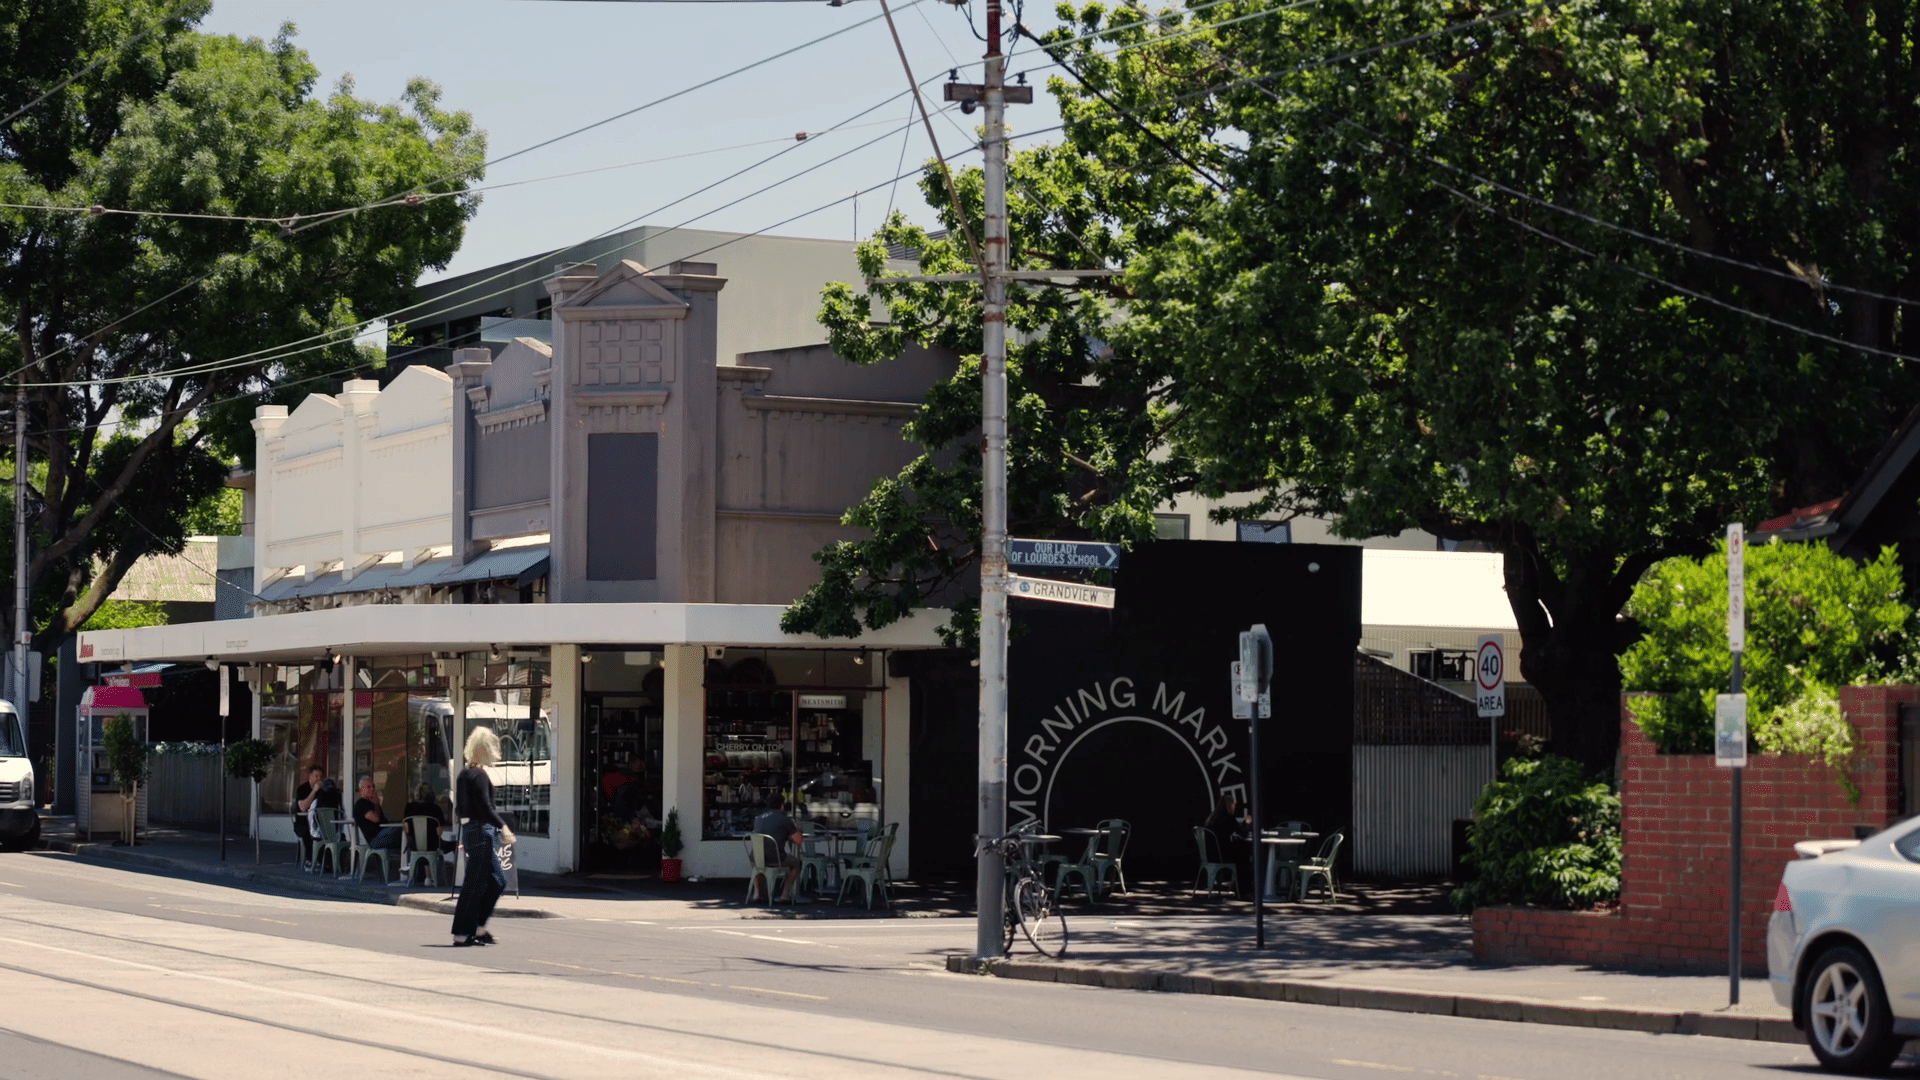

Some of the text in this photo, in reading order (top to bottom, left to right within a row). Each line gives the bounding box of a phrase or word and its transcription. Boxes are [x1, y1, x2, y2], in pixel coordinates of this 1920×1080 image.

[1034, 542, 1078, 555] OUR LADY
[1011, 551, 1101, 566] OF LOURDES SCHOOL
[1033, 582, 1099, 603] GRANDVIEW
[1481, 655, 1499, 676] 40
[801, 698, 844, 706] MEATSMITH
[1478, 696, 1504, 711] AREA
[716, 742, 785, 751] CHERRY ON TOP
[1009, 676, 1136, 832] MORNING
